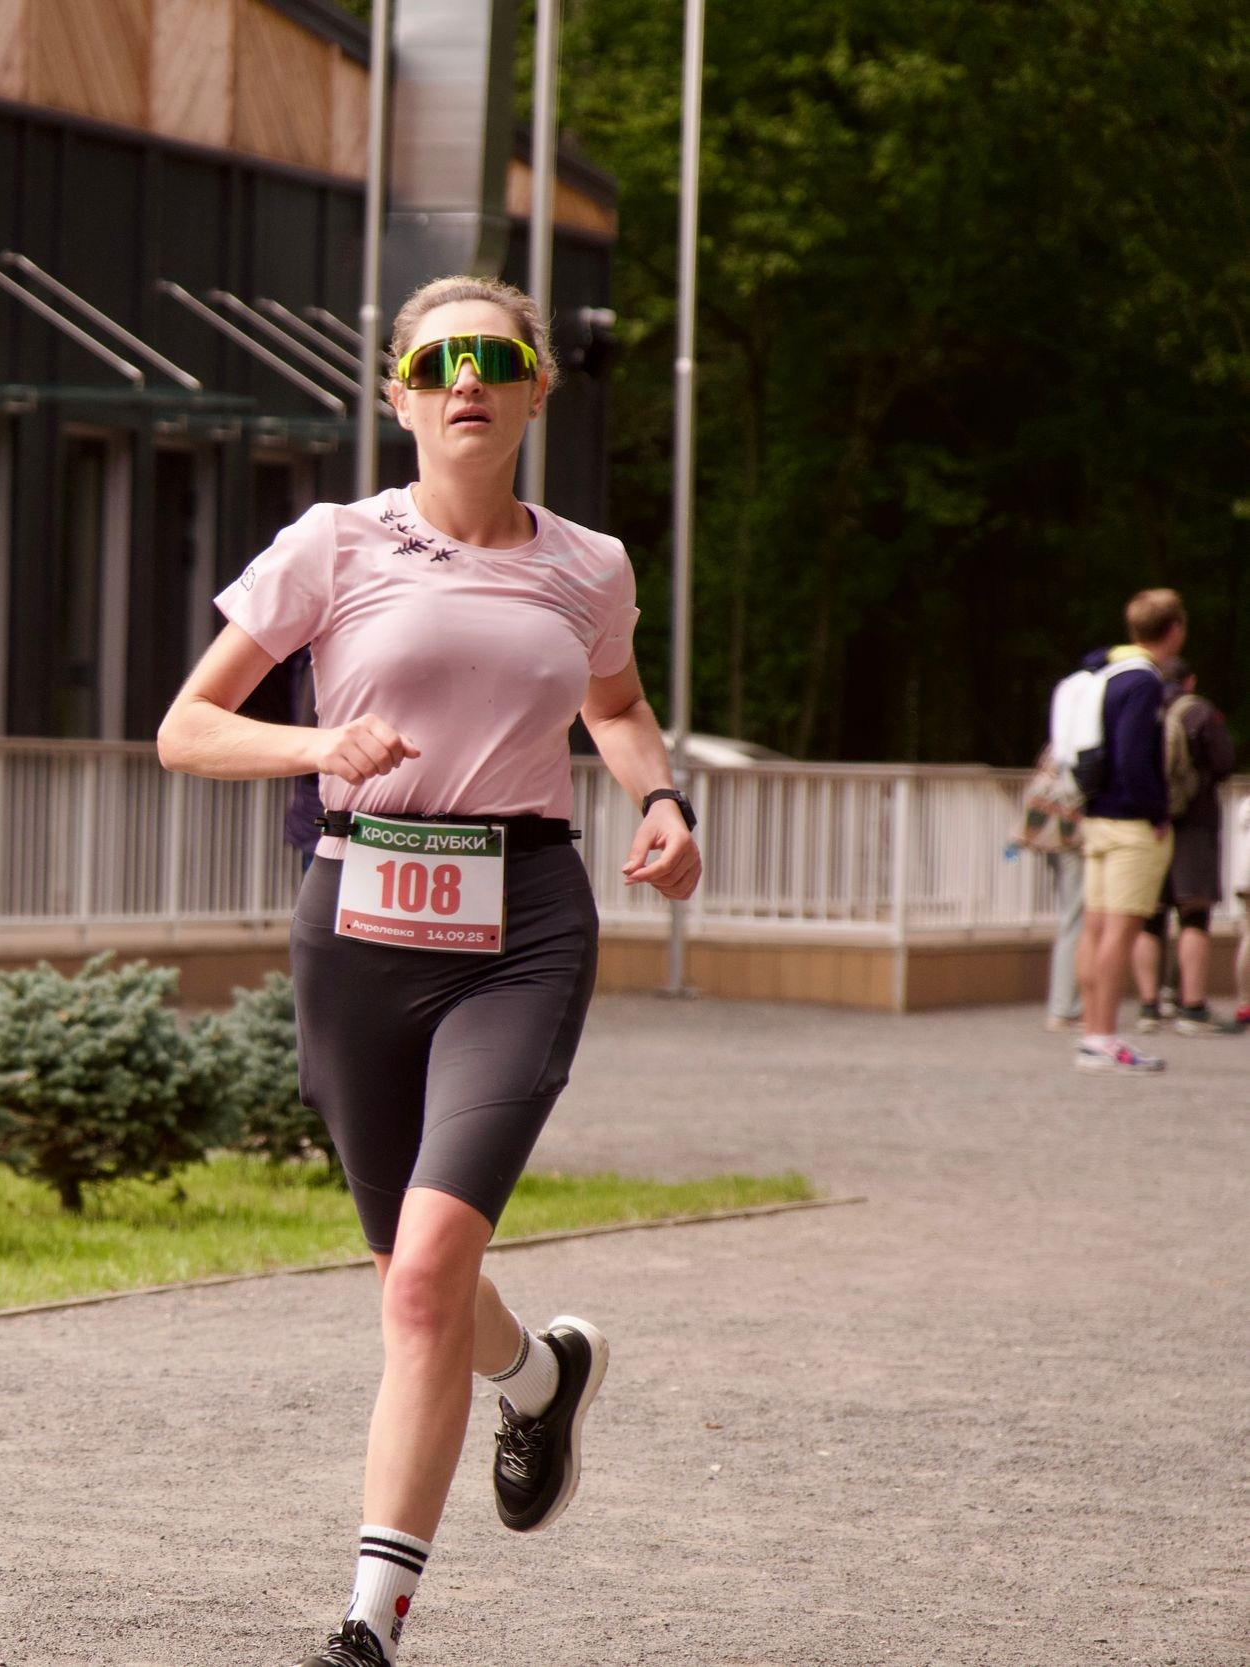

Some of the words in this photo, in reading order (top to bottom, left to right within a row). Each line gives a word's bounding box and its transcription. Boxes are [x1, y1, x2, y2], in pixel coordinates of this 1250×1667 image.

[361, 826, 421, 848] КРОСС
[424, 834, 487, 851] ДУБКИ
[376, 859, 462, 916] 108
[352, 919, 415, 938] Апрелевка
[426, 929, 485, 943] 14.09.25
